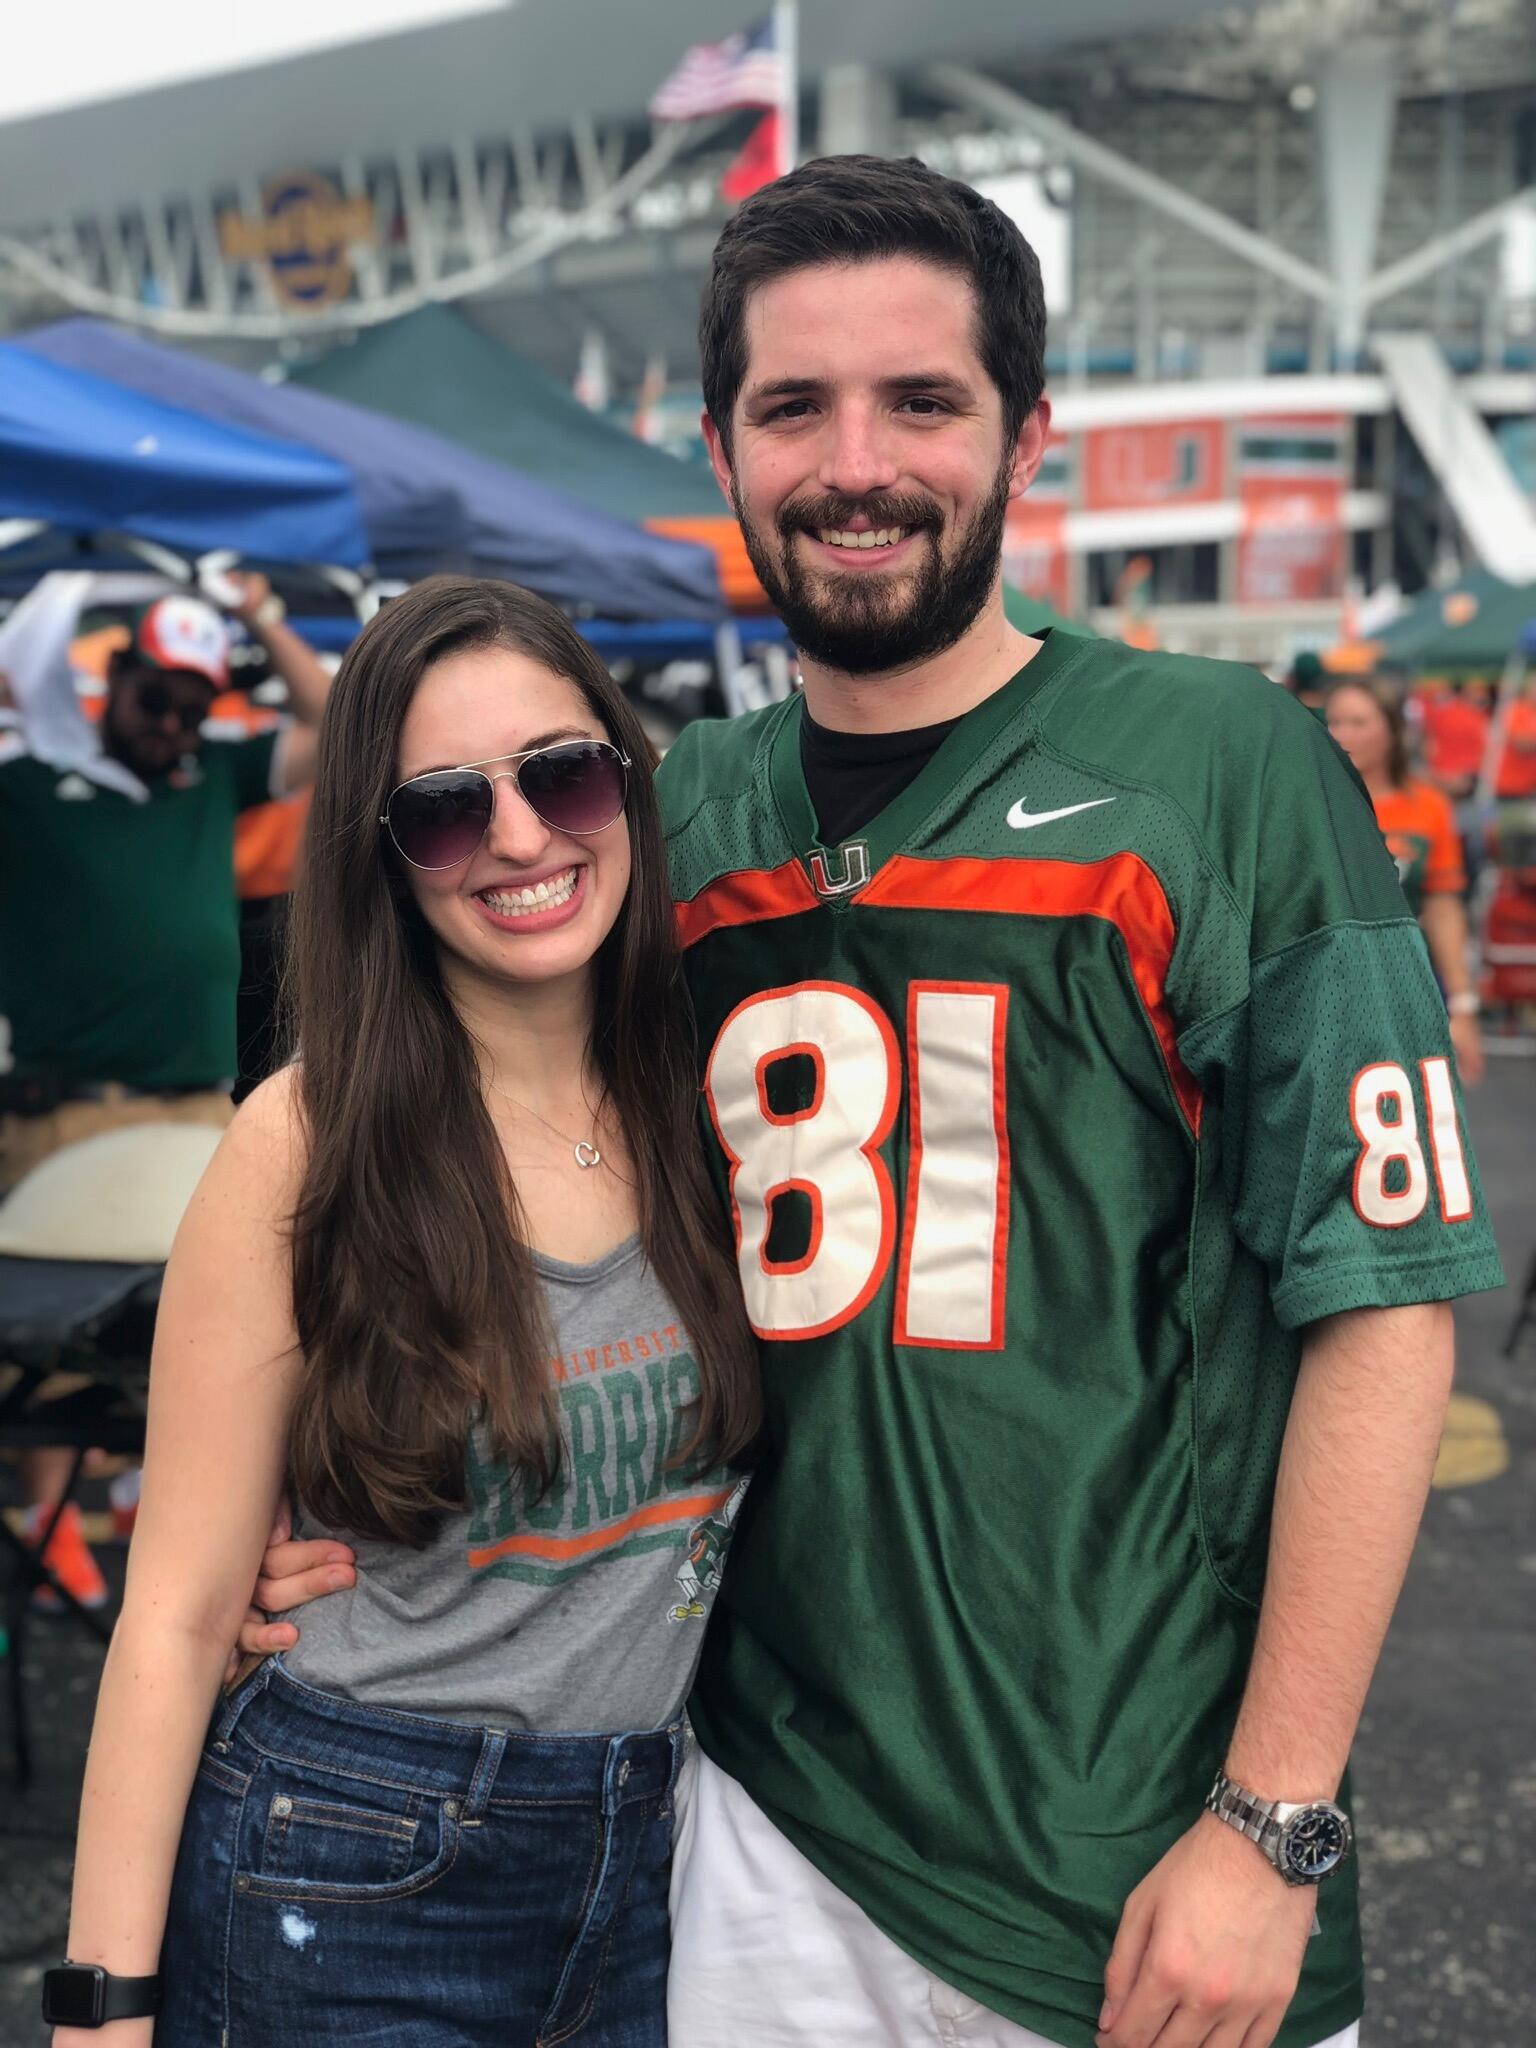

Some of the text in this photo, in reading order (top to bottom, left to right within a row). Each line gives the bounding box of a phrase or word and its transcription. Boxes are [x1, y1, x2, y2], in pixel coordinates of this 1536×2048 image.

[806, 839, 871, 899] U
[704, 979, 1009, 1351] 81
[1348, 1056, 1473, 1230] 81
[548, 1323, 690, 1383] NIVERSIT
